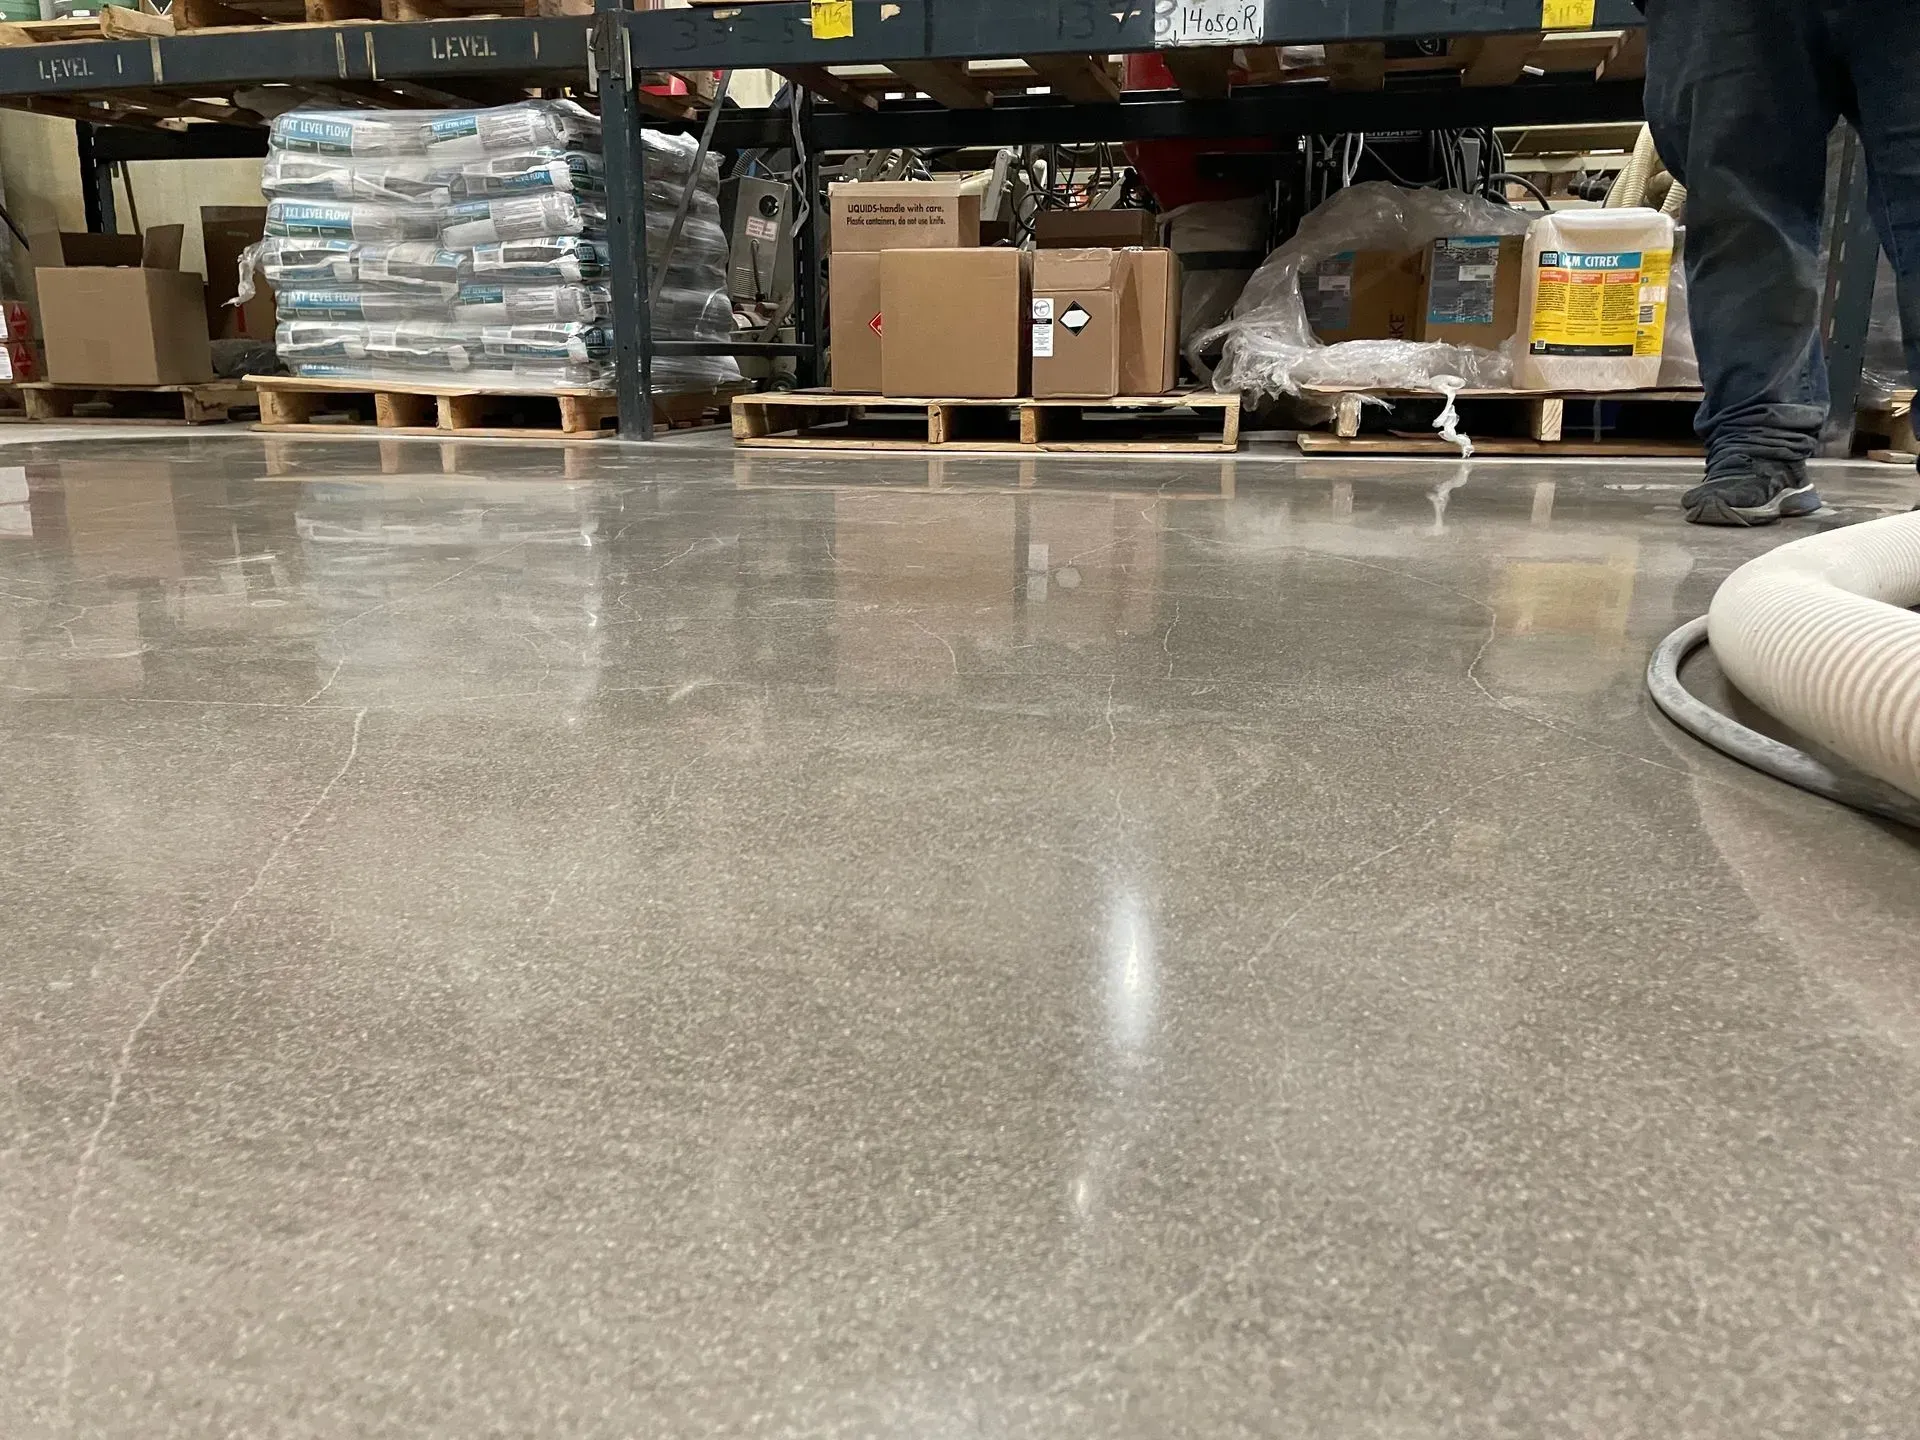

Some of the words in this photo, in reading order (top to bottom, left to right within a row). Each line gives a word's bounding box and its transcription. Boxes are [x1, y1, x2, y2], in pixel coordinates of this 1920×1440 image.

[432, 36, 497, 60] LEVEL
[38, 57, 94, 83] LEVEL
[301, 121, 323, 135] LEVEL
[326, 125, 350, 138] FLOW
[301, 207, 323, 219] LEVEL
[325, 208, 350, 221] FLOW
[907, 203, 924, 213] with
[925, 205, 945, 213] care.
[846, 216, 865, 225] Plastic
[898, 216, 906, 225] do
[907, 217, 917, 225] not
[918, 217, 928, 225] use
[929, 215, 946, 225] knife.
[1584, 255, 1619, 267] CITREX
